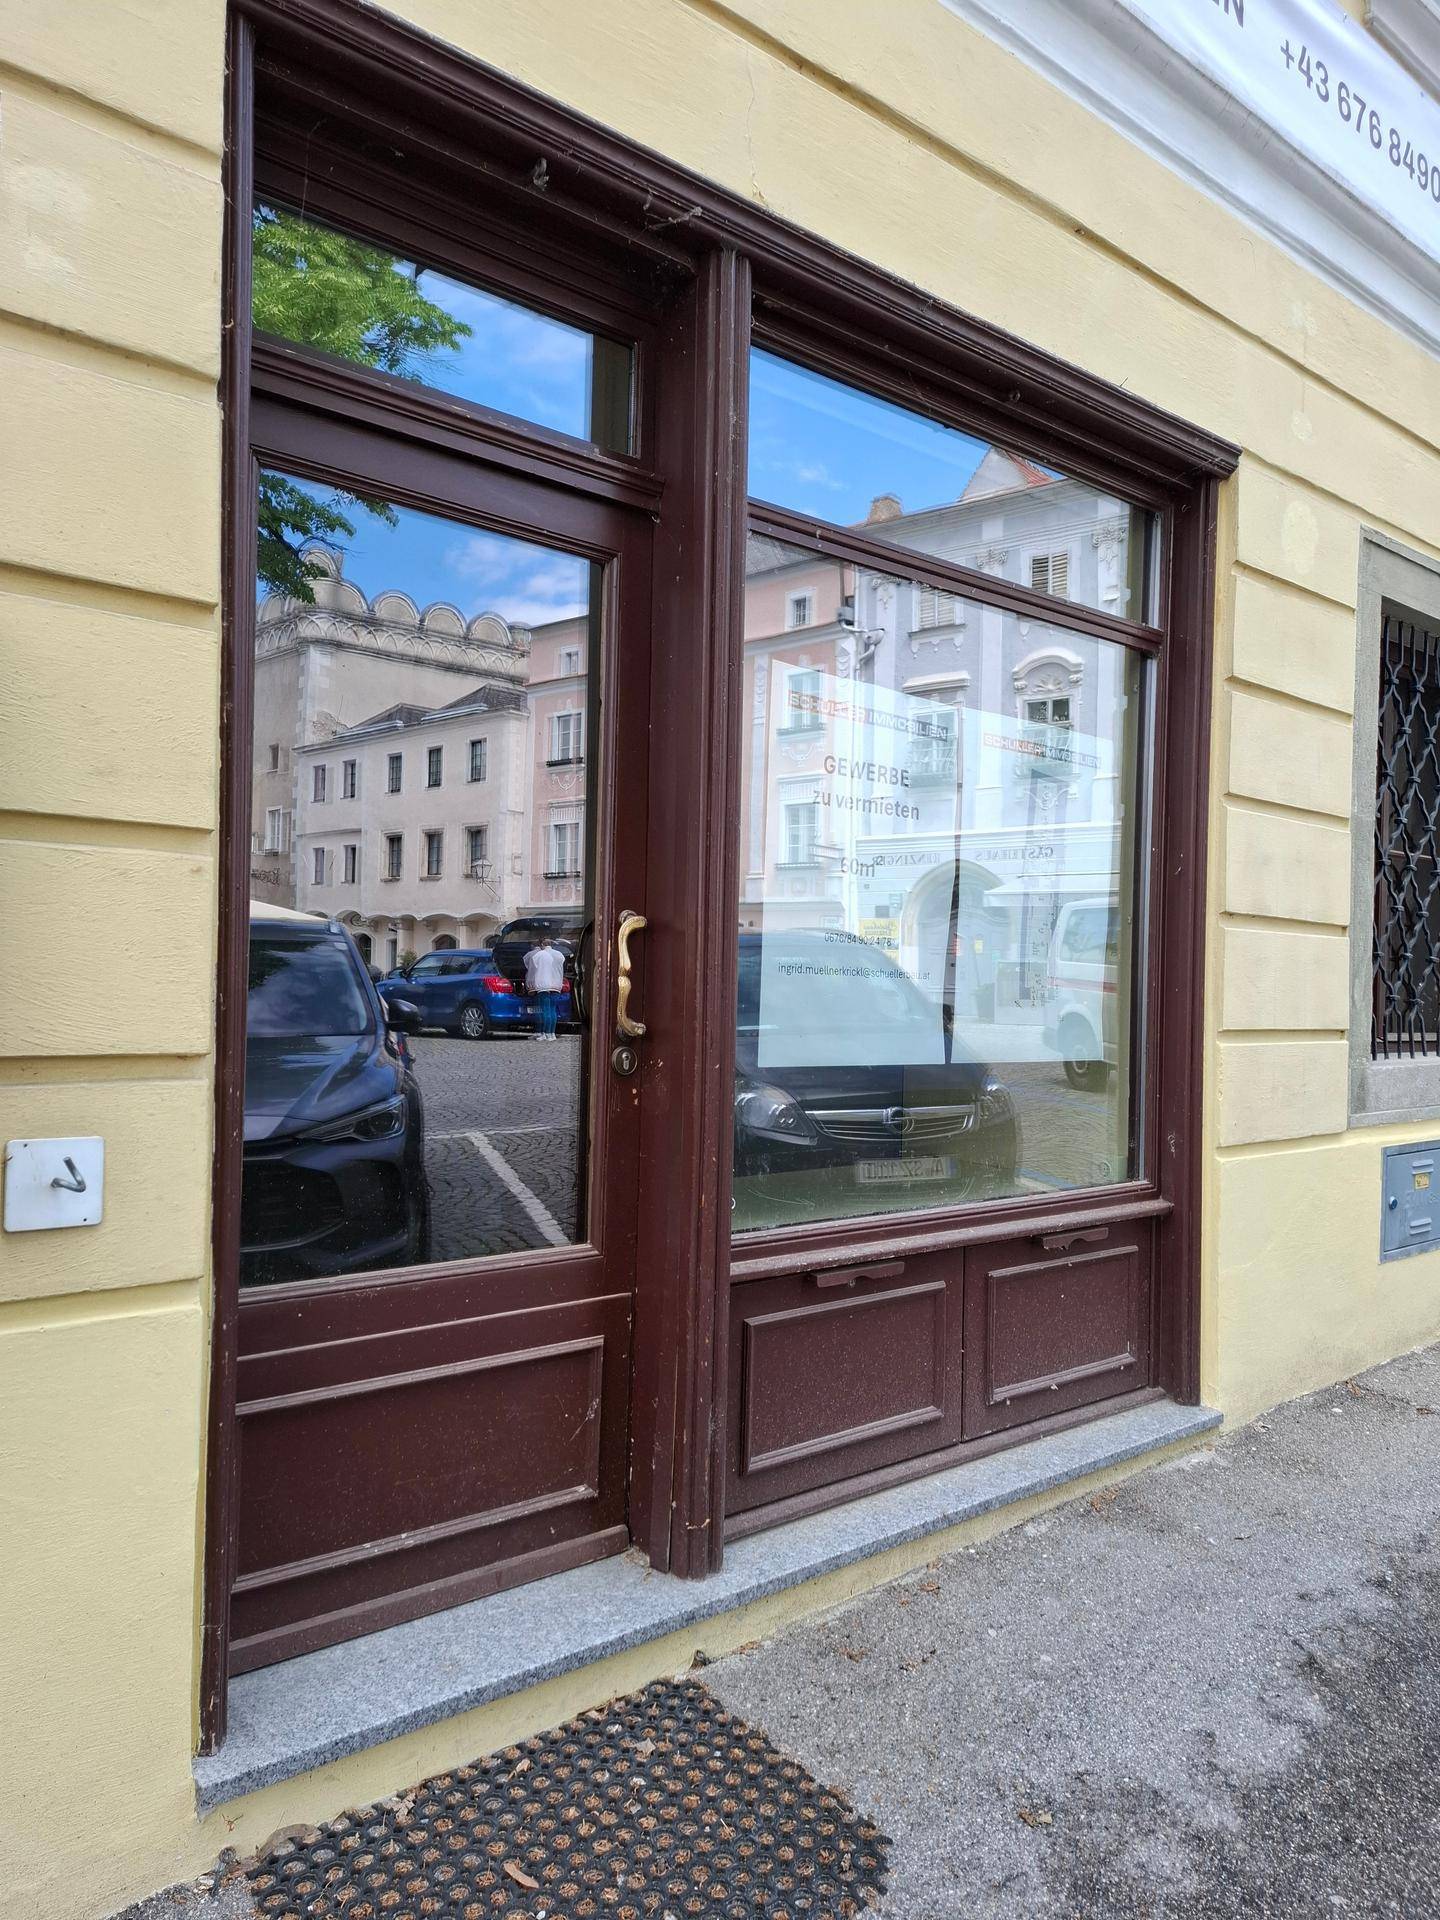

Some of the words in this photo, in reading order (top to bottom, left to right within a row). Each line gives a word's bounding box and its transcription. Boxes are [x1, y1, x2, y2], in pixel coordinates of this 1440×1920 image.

[1280, 39, 1330, 103] +43
[1337, 80, 1382, 150] 676
[869, 711, 947, 739] IMMOBILIEN
[823, 754, 913, 788] GEWERBE
[812, 789, 832, 808] zu
[835, 793, 920, 820] vermieten
